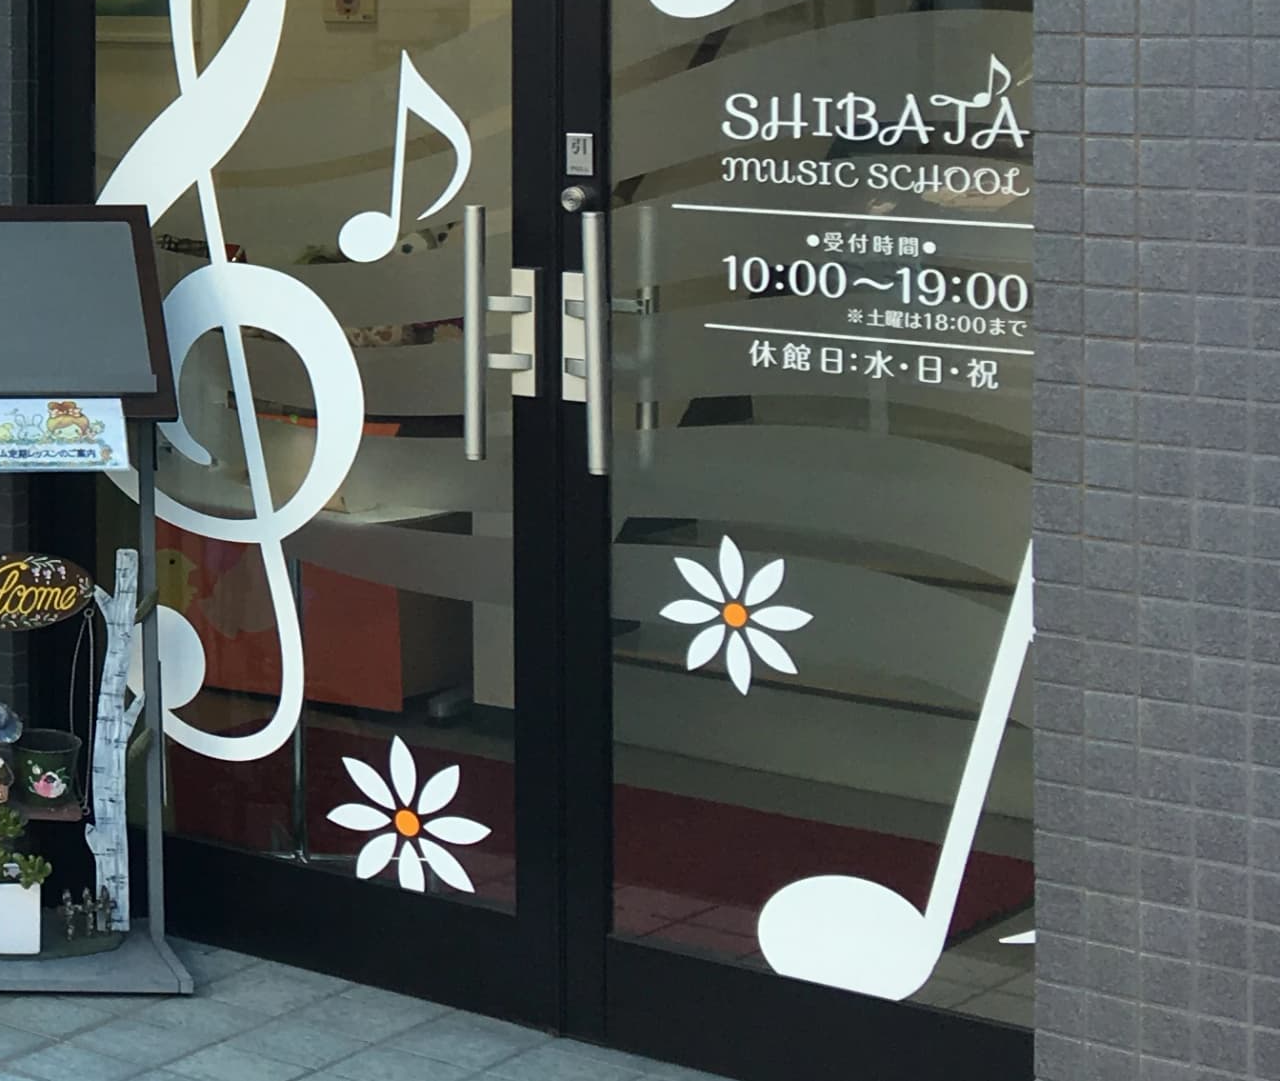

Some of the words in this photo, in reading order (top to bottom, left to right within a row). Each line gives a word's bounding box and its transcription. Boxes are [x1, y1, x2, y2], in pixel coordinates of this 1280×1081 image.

[721, 92, 1031, 149] SHIBATA
[721, 157, 860, 187] MUSIC
[867, 163, 1030, 196] SCHOOL
[823, 232, 920, 258] 受付時間
[721, 254, 1029, 313] 10:00～19:00
